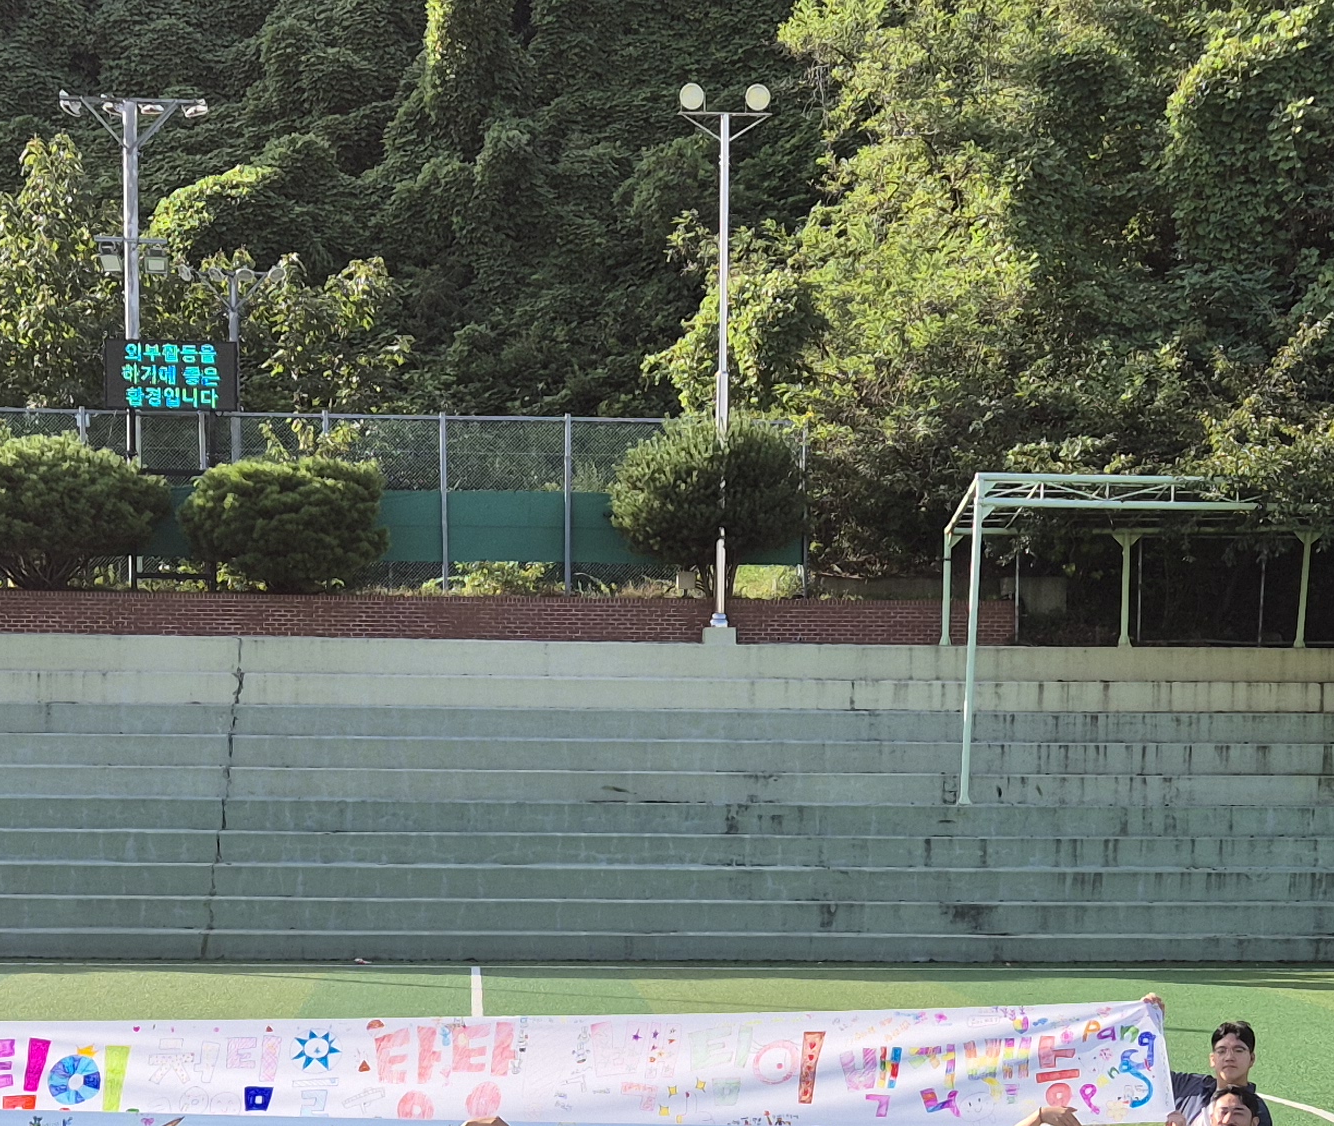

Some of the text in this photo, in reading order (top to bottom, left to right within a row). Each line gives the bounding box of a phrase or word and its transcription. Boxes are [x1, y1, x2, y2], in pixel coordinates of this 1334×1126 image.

[125, 343, 217, 364] 외부활동을
[121, 363, 220, 386] 하기에 좋은
[125, 386, 218, 408] 환경입니다
